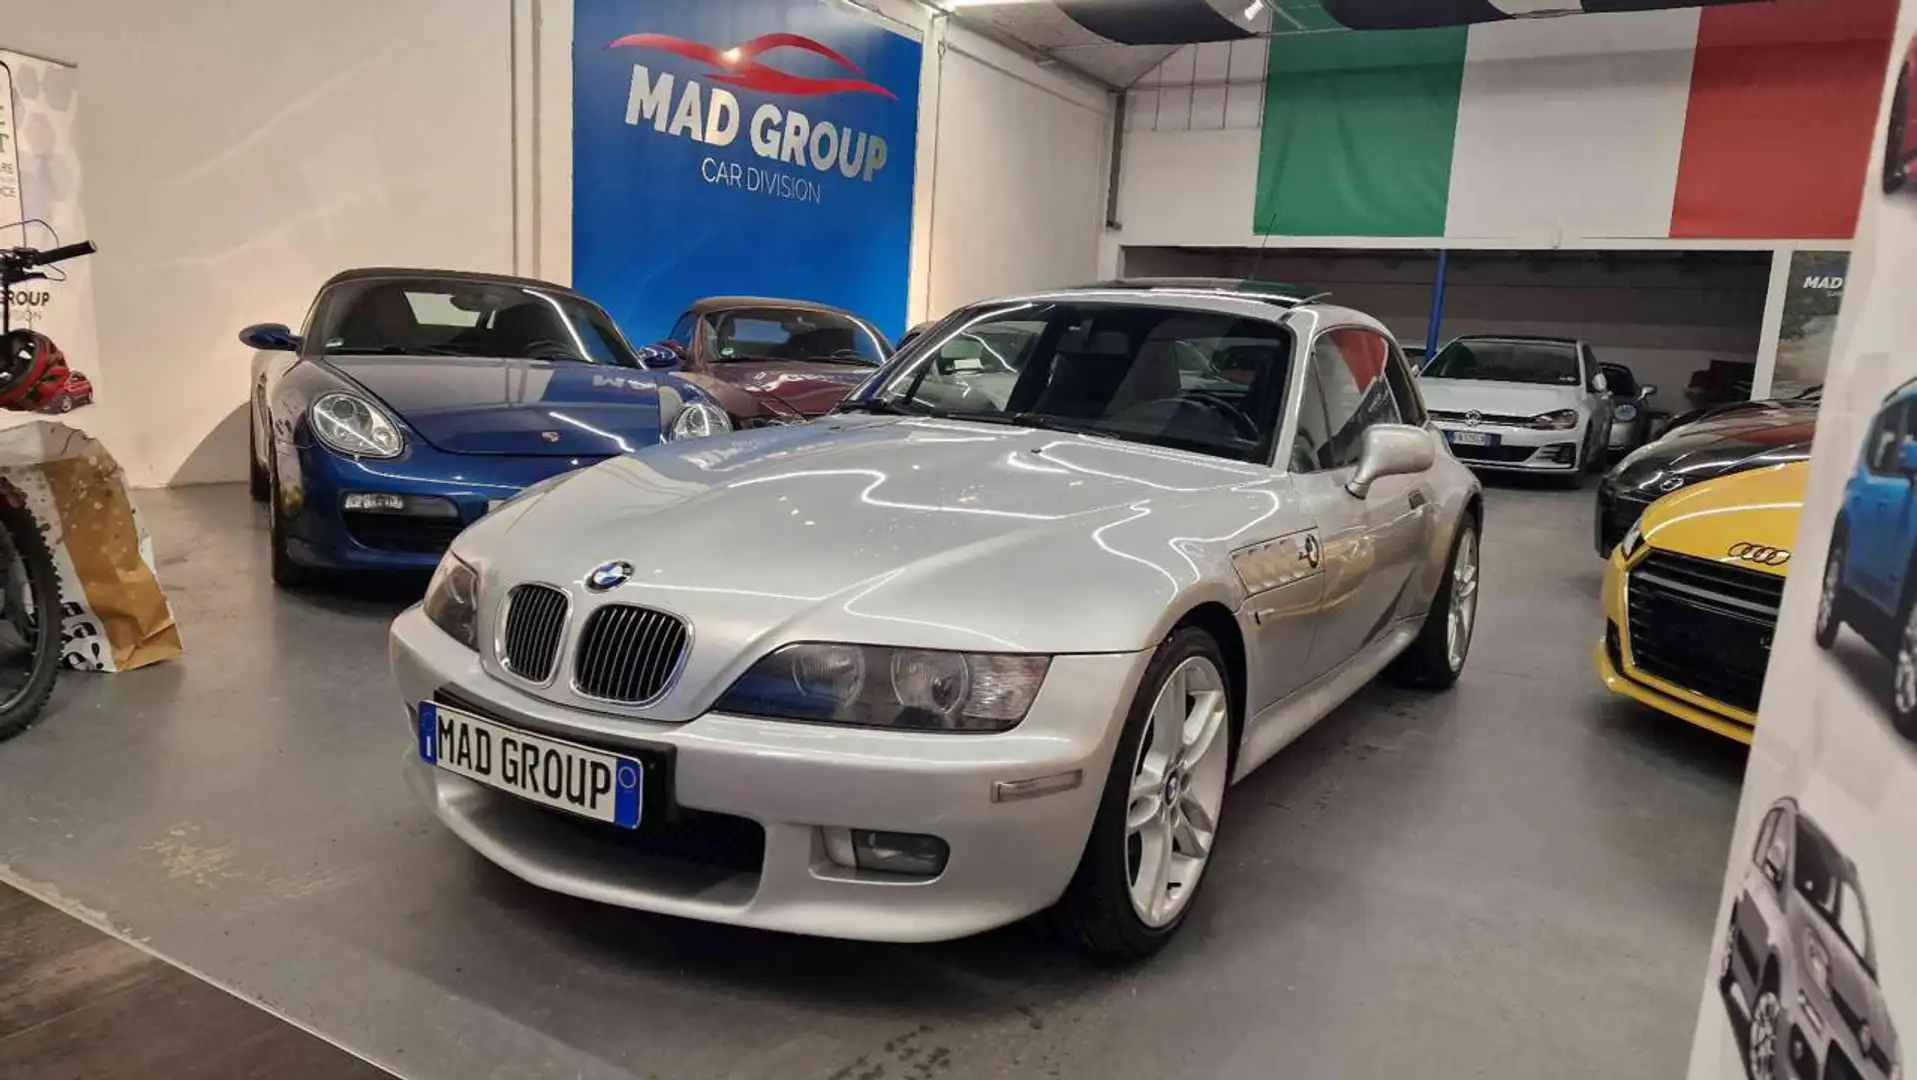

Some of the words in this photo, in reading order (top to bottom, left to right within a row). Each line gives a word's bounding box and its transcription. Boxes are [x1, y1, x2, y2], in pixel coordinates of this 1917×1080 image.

[625, 63, 741, 147] MAD
[749, 103, 888, 182] GROUP
[701, 157, 742, 188] CAR
[747, 167, 821, 204] DIVISION
[0, 290, 50, 306] ROUP
[1802, 275, 1844, 289] MAD
[437, 714, 492, 776] MAD
[501, 736, 612, 810] GROUP
